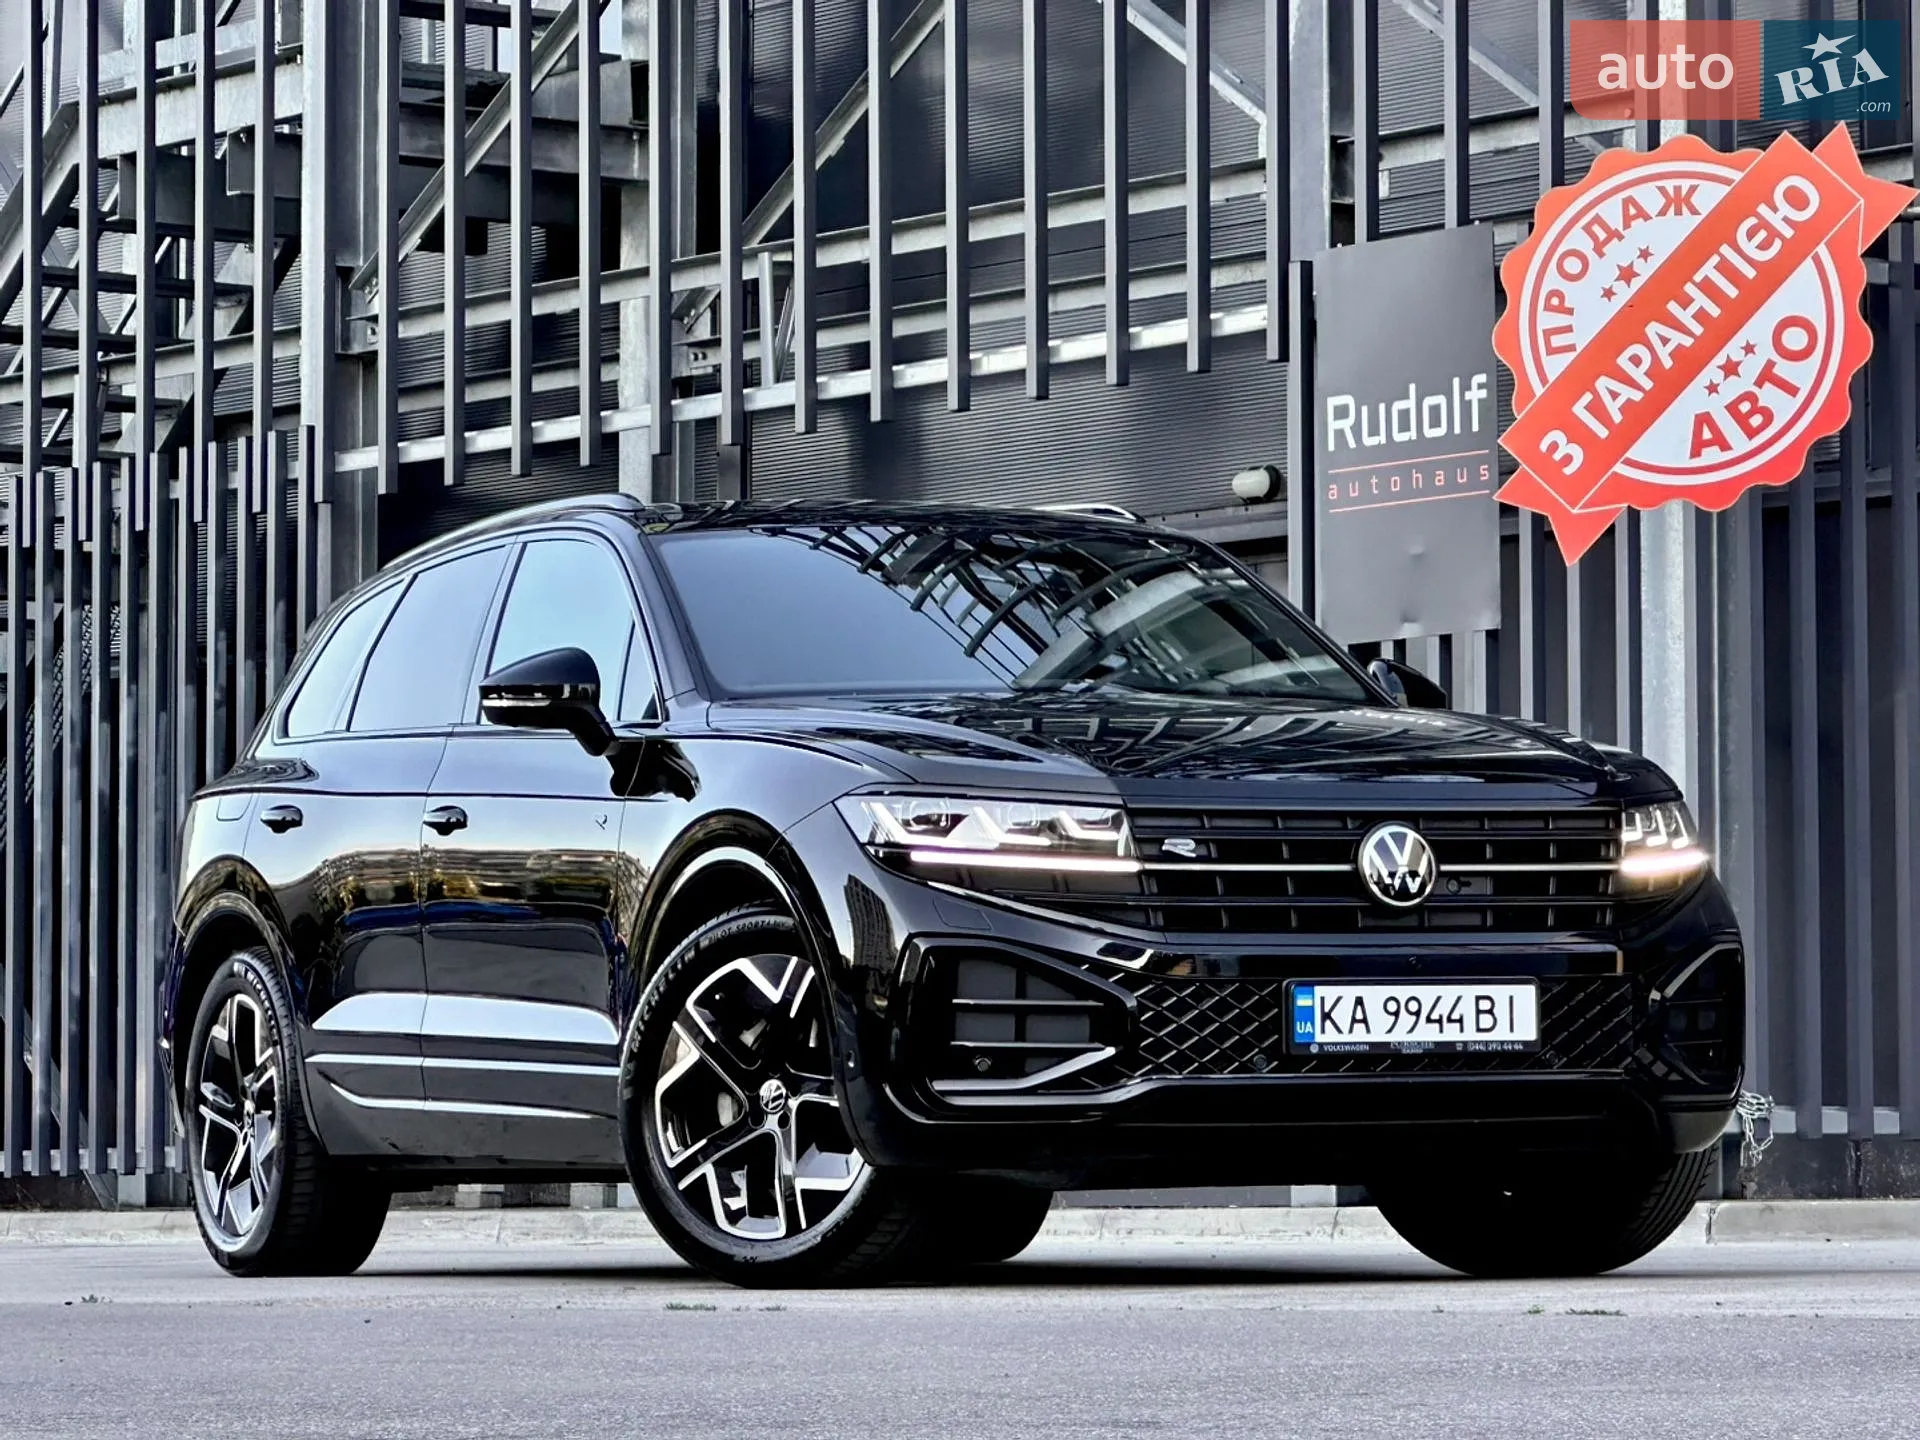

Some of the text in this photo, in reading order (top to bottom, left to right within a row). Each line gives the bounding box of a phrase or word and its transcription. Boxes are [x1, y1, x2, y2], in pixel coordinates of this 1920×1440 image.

[1327, 373, 1488, 452] Rudolf
[1328, 463, 1490, 501] autohaus
[1296, 1021, 1314, 1034] UA
[1320, 995, 1515, 1035] KA 9944 BI
